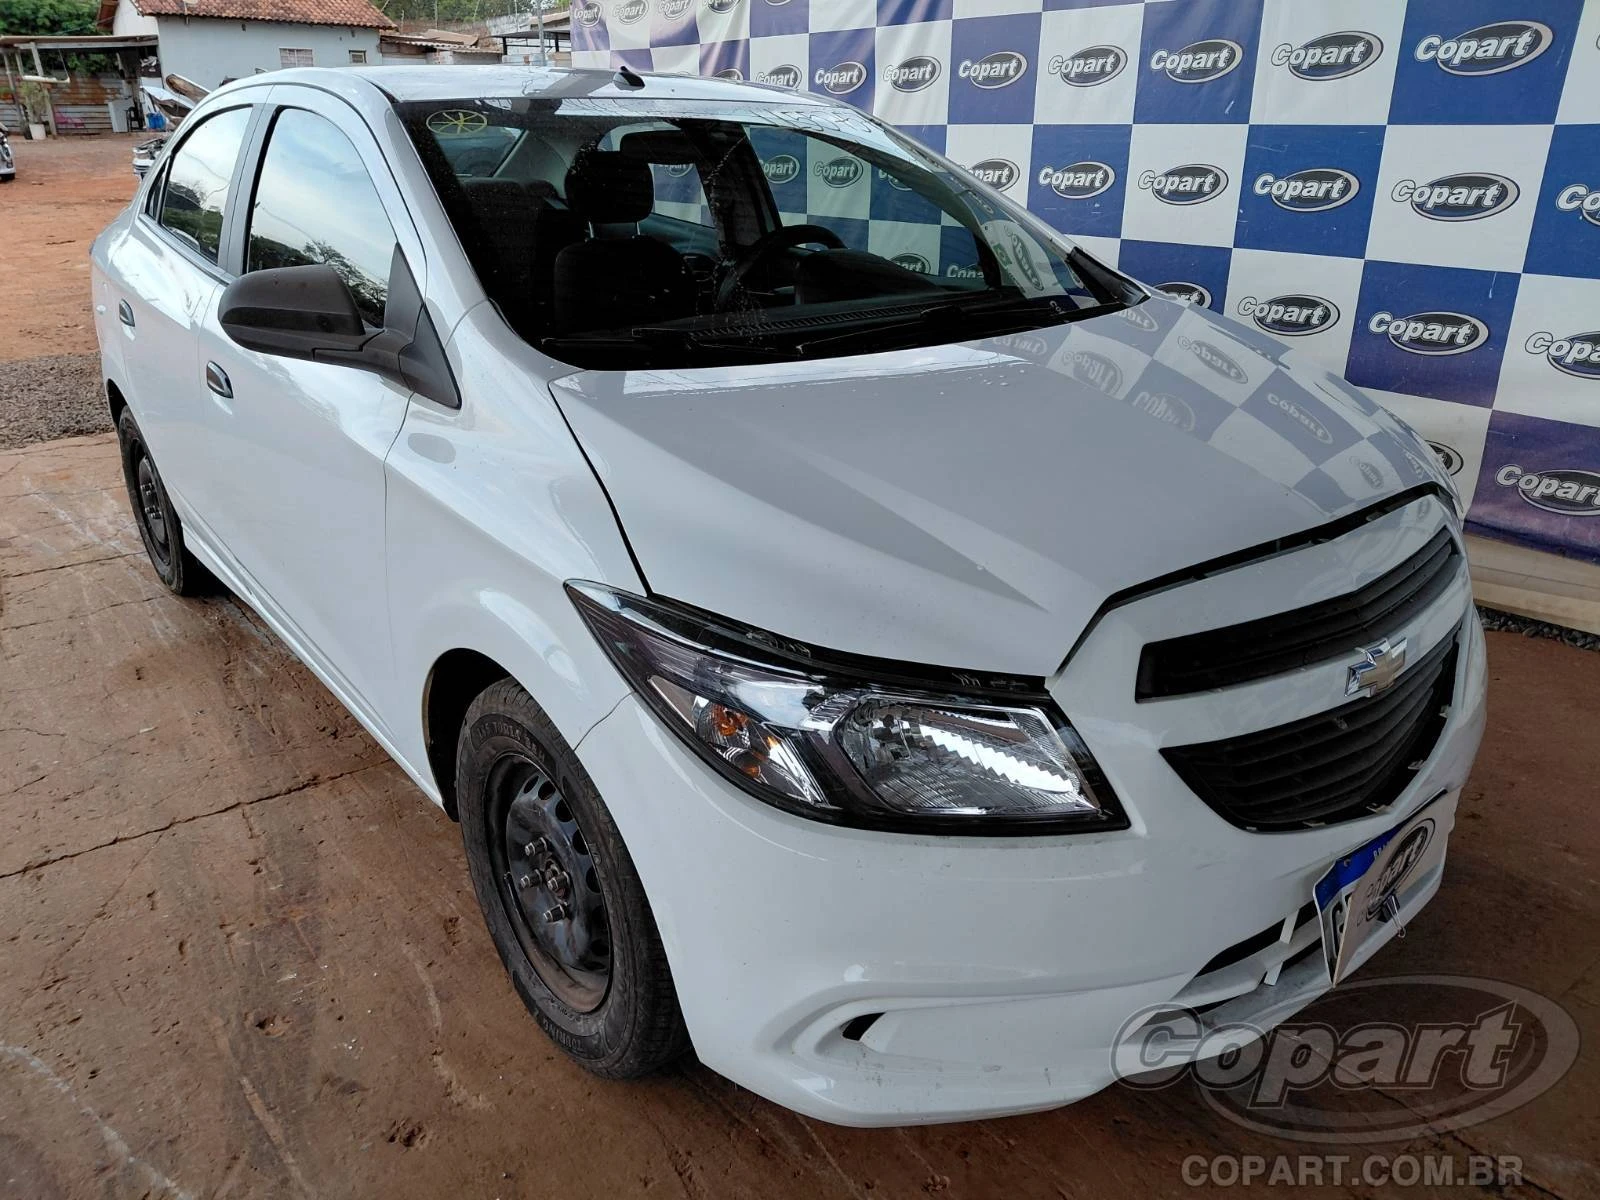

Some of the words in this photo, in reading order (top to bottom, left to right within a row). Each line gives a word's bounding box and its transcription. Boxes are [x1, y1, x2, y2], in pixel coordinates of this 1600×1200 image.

[574, 7, 598, 19] Copart
[613, 6, 643, 18] Copart
[1271, 38, 1367, 71] Copart
[1414, 26, 1536, 66] Copart
[883, 63, 932, 83] Copart
[958, 57, 1020, 81] Copart
[1048, 51, 1118, 79] Copart
[1150, 46, 1230, 75] Copart
[815, 67, 859, 88] Copart
[814, 160, 855, 179] Copart
[1038, 167, 1105, 191] Copart
[1138, 169, 1217, 196] Copart
[1253, 172, 1347, 203] Copart
[1391, 179, 1502, 209] Copart
[1237, 296, 1327, 325] Copart
[1368, 312, 1476, 346] Copart
